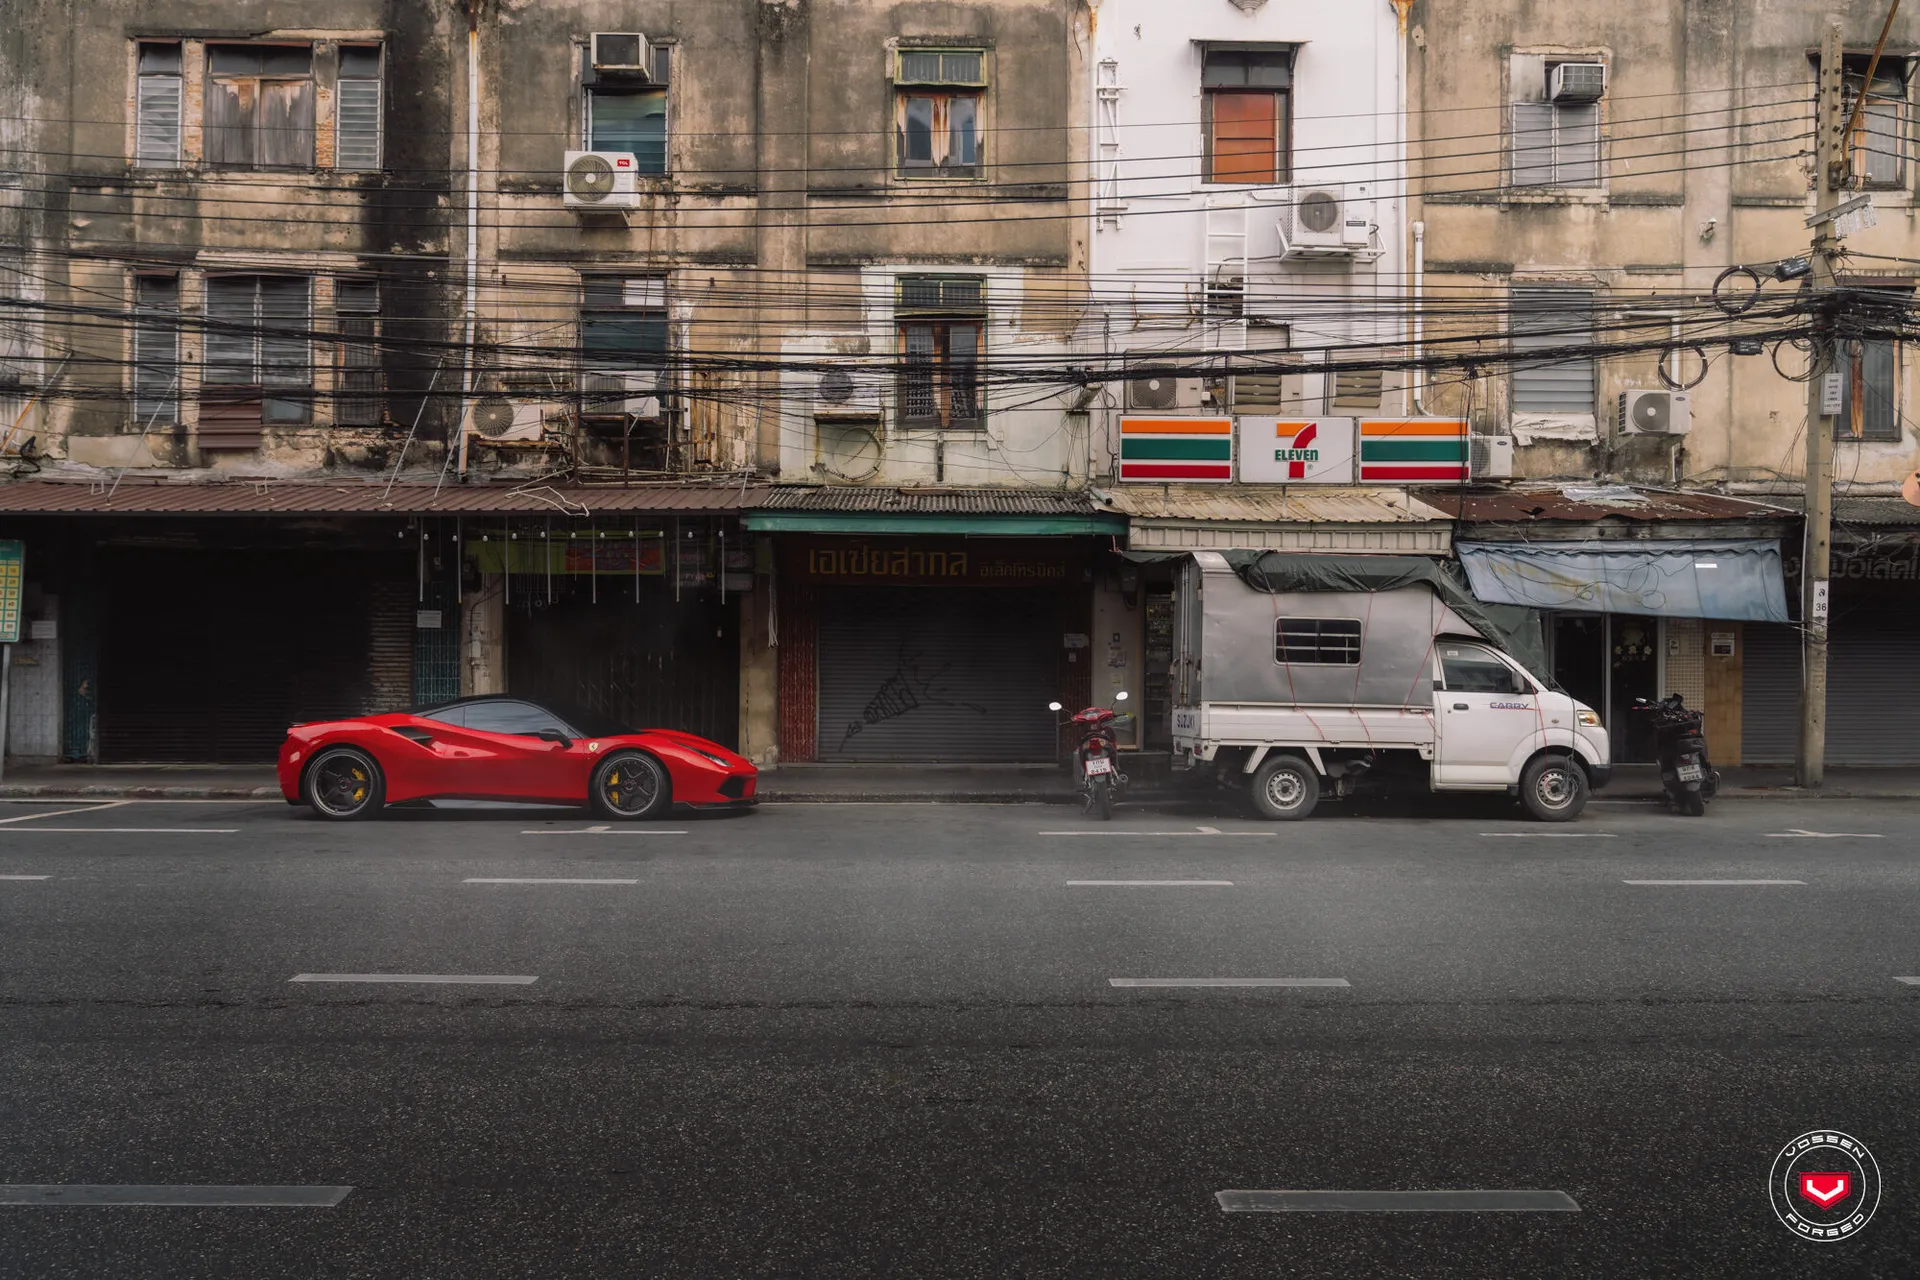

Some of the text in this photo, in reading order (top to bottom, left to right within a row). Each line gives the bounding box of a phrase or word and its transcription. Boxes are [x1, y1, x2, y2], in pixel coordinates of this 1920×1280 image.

[1277, 423, 1317, 478] 7
[1816, 603, 1827, 612] 36
[1489, 701, 1529, 709] CARRY
